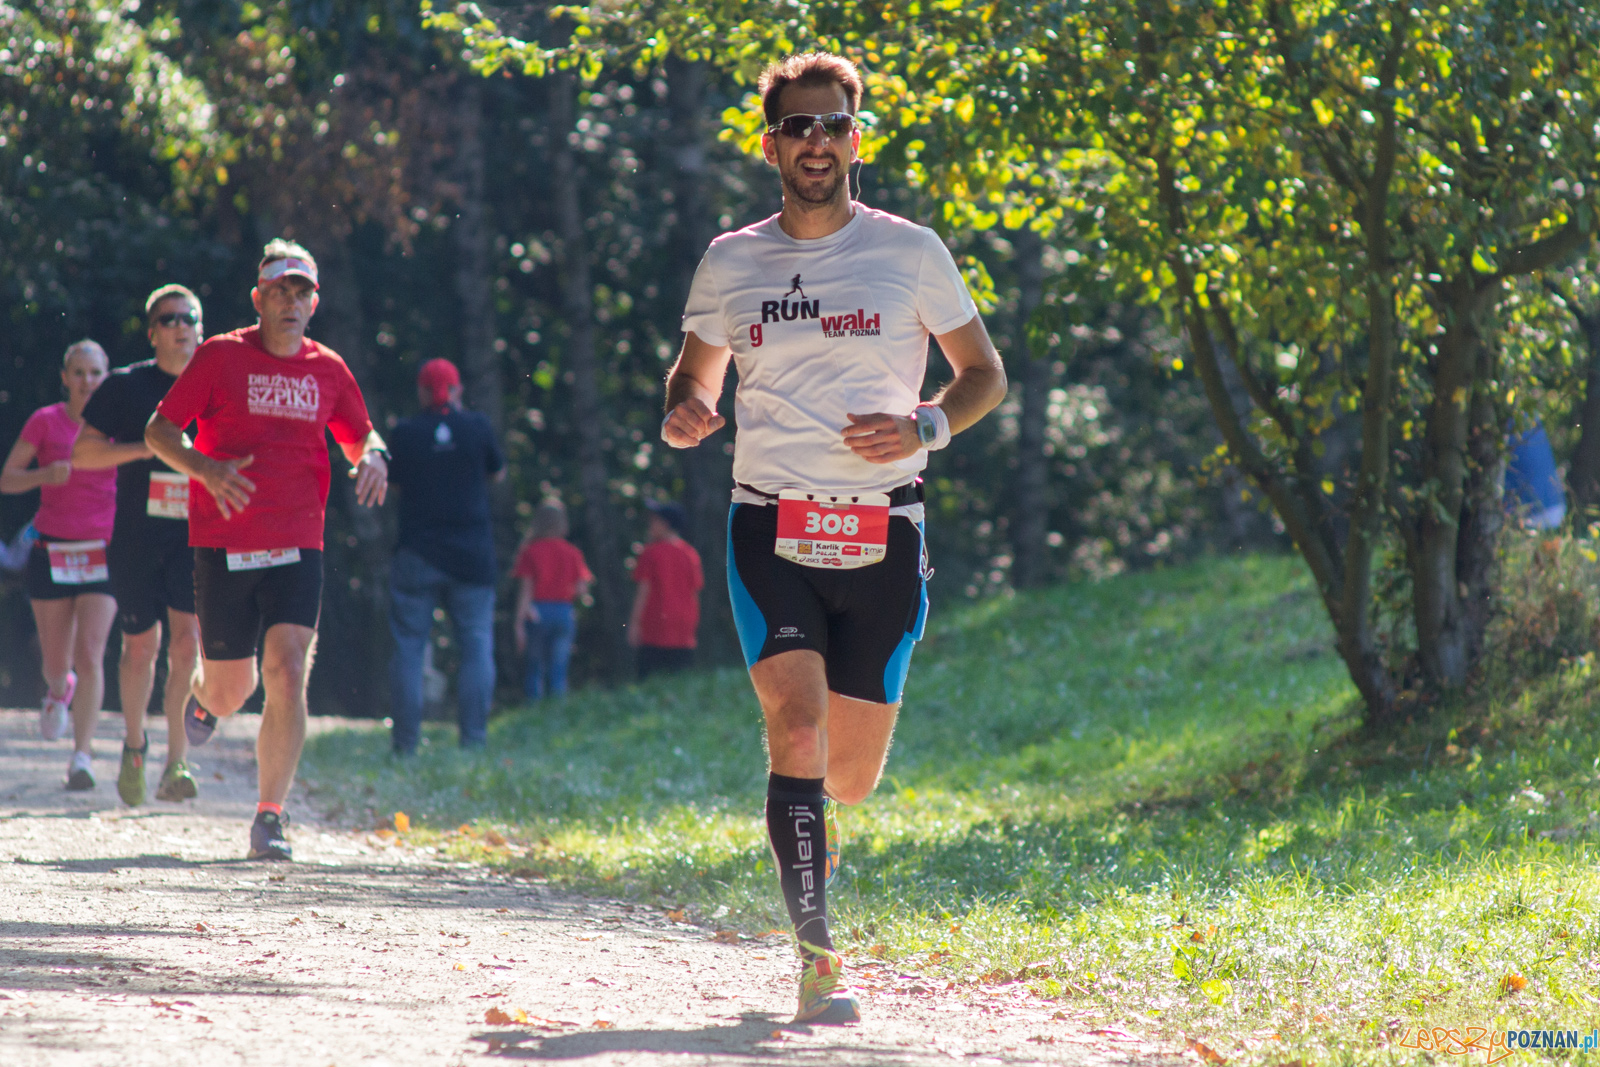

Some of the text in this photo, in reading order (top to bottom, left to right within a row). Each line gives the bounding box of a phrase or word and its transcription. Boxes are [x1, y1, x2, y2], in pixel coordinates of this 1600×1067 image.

[248, 387, 319, 411] SZPIKU
[804, 511, 859, 536] 308
[816, 543, 840, 551] Karlik
[789, 805, 816, 913] kalenji
